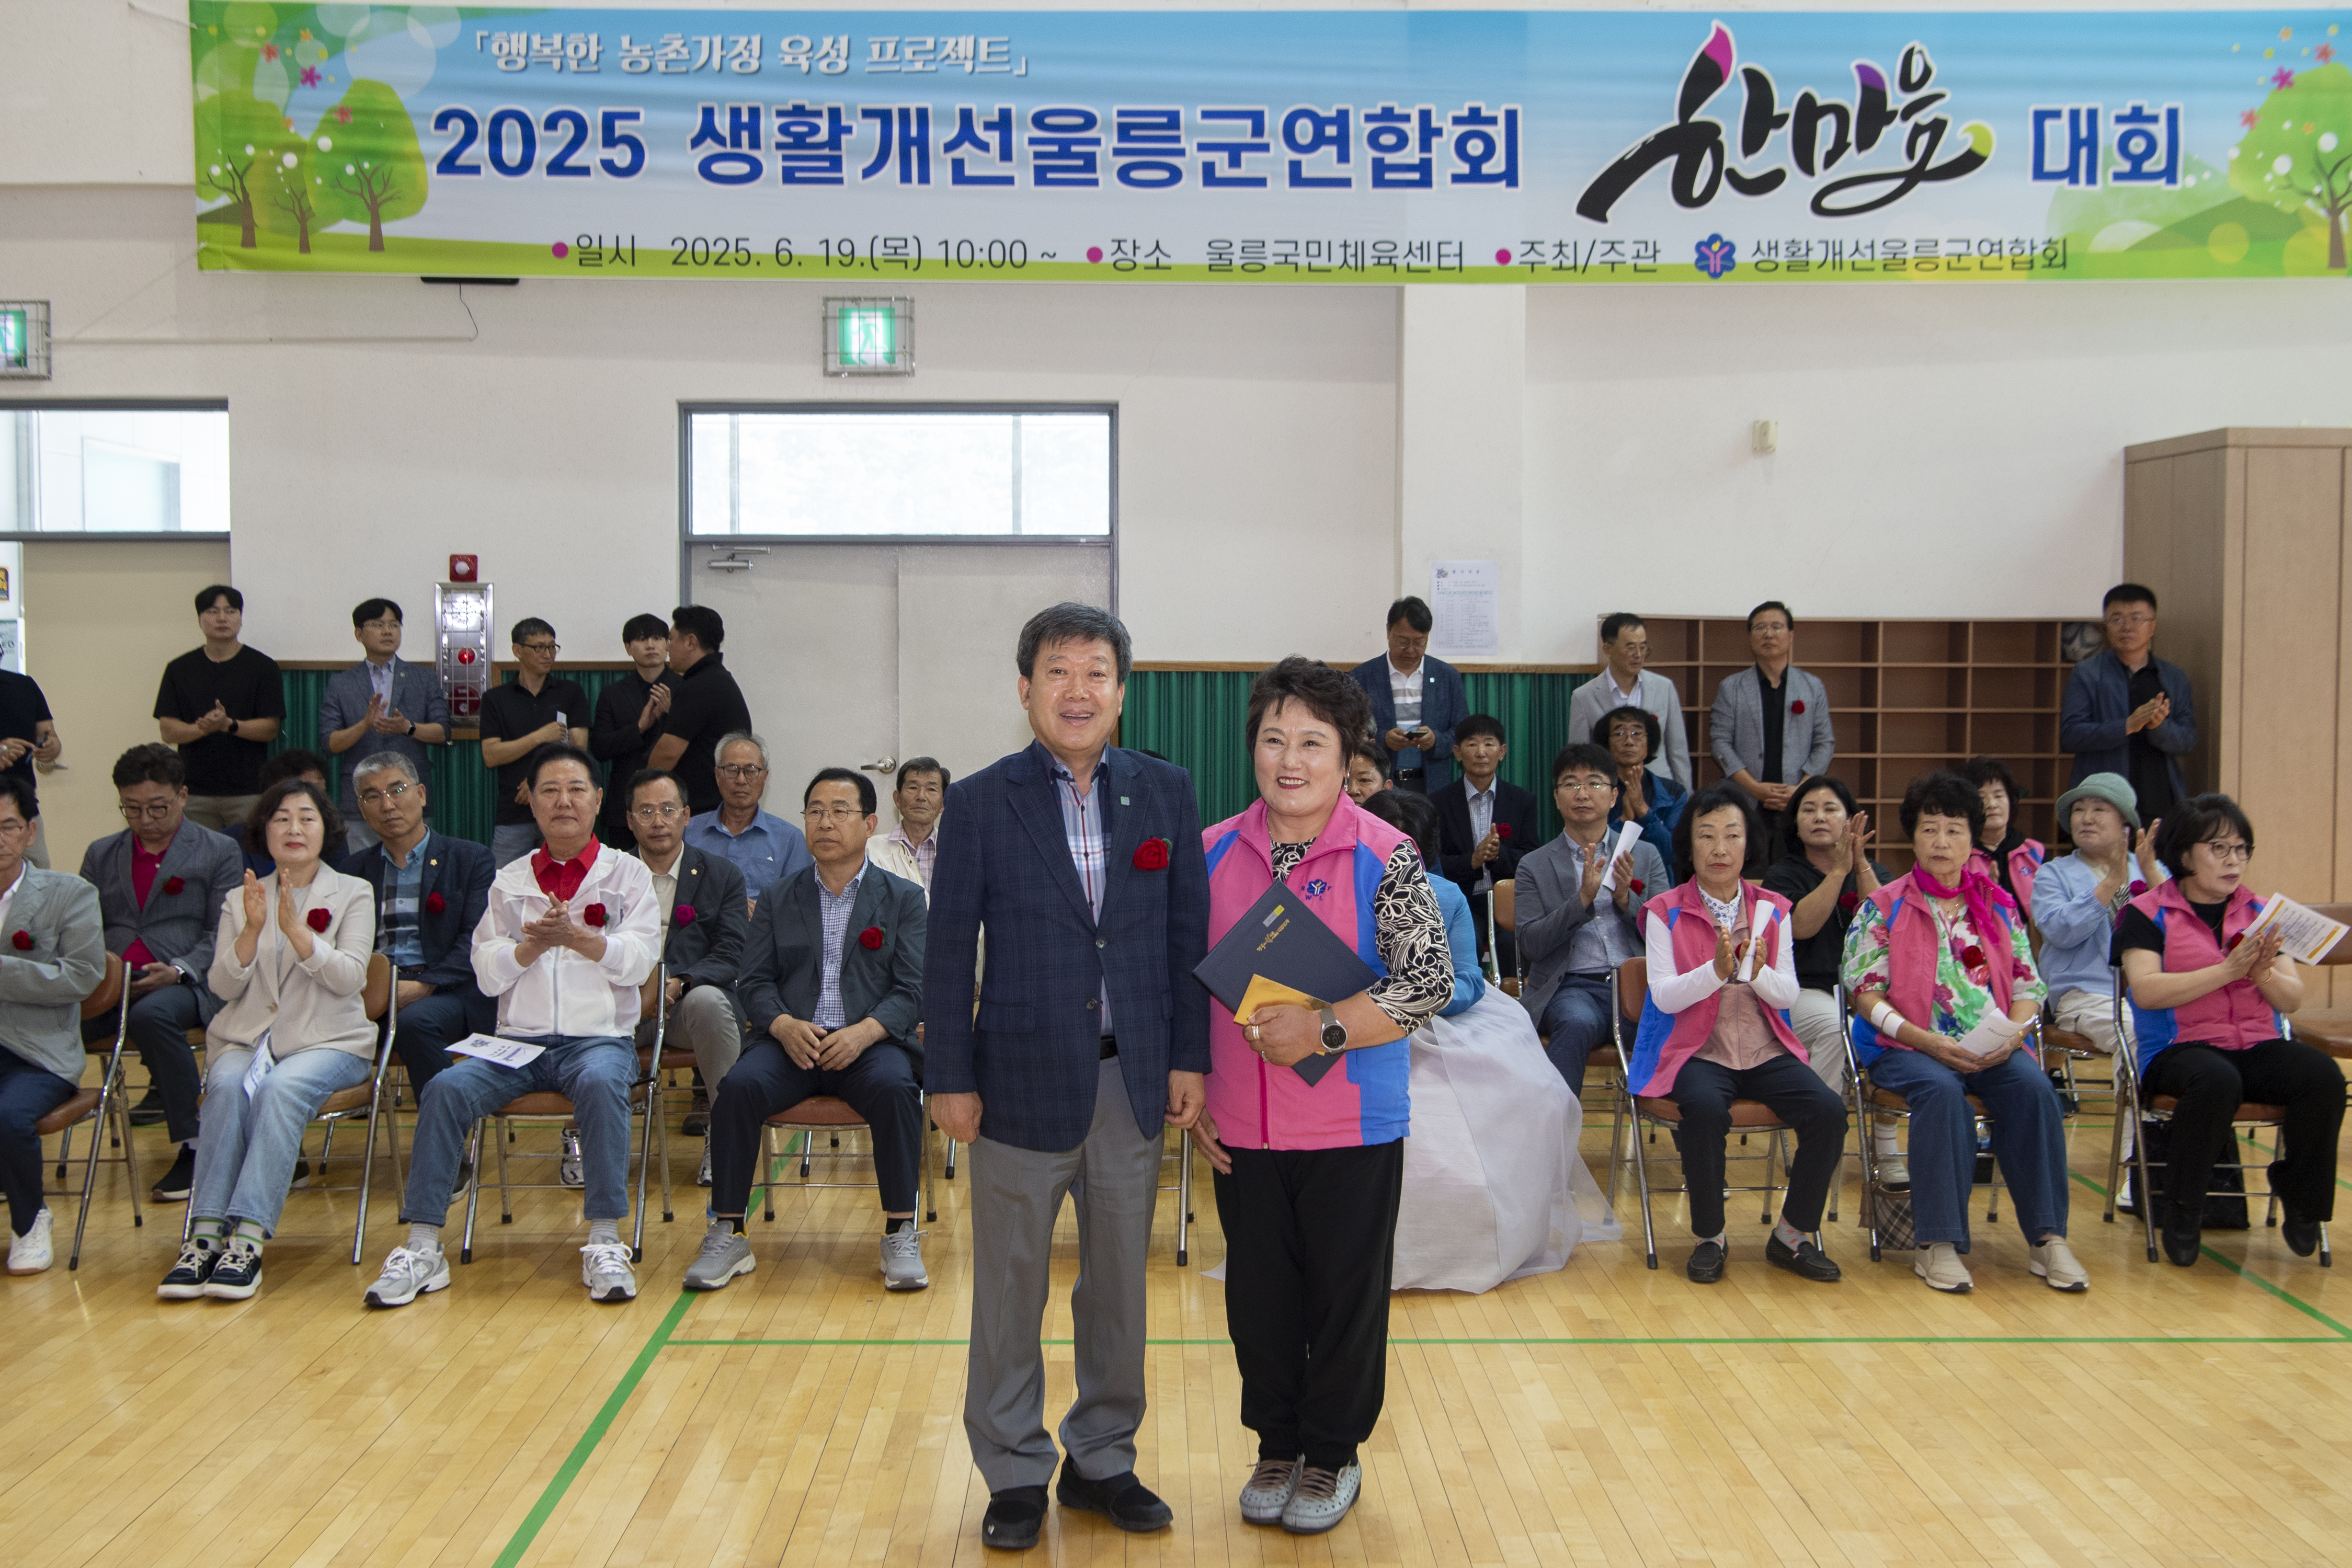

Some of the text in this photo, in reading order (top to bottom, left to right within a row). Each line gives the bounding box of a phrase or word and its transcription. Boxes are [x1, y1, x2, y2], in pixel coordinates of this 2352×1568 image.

[475, 30, 1027, 76] 「행복한 농촌가정 육성 프로젝트」
[433, 23, 2180, 224] 2025 생활개선울릉군연합회 한마음 대회
[576, 234, 635, 268] 일시
[671, 236, 761, 267] 2025.
[775, 237, 803, 267] 6.
[818, 235, 922, 272] 19.(목)
[938, 239, 1027, 269] 10:00
[1111, 238, 1464, 273] 장소 울릉국민체육센터
[1518, 237, 2068, 274] 주최/주관 생활개선울릉군연합회
